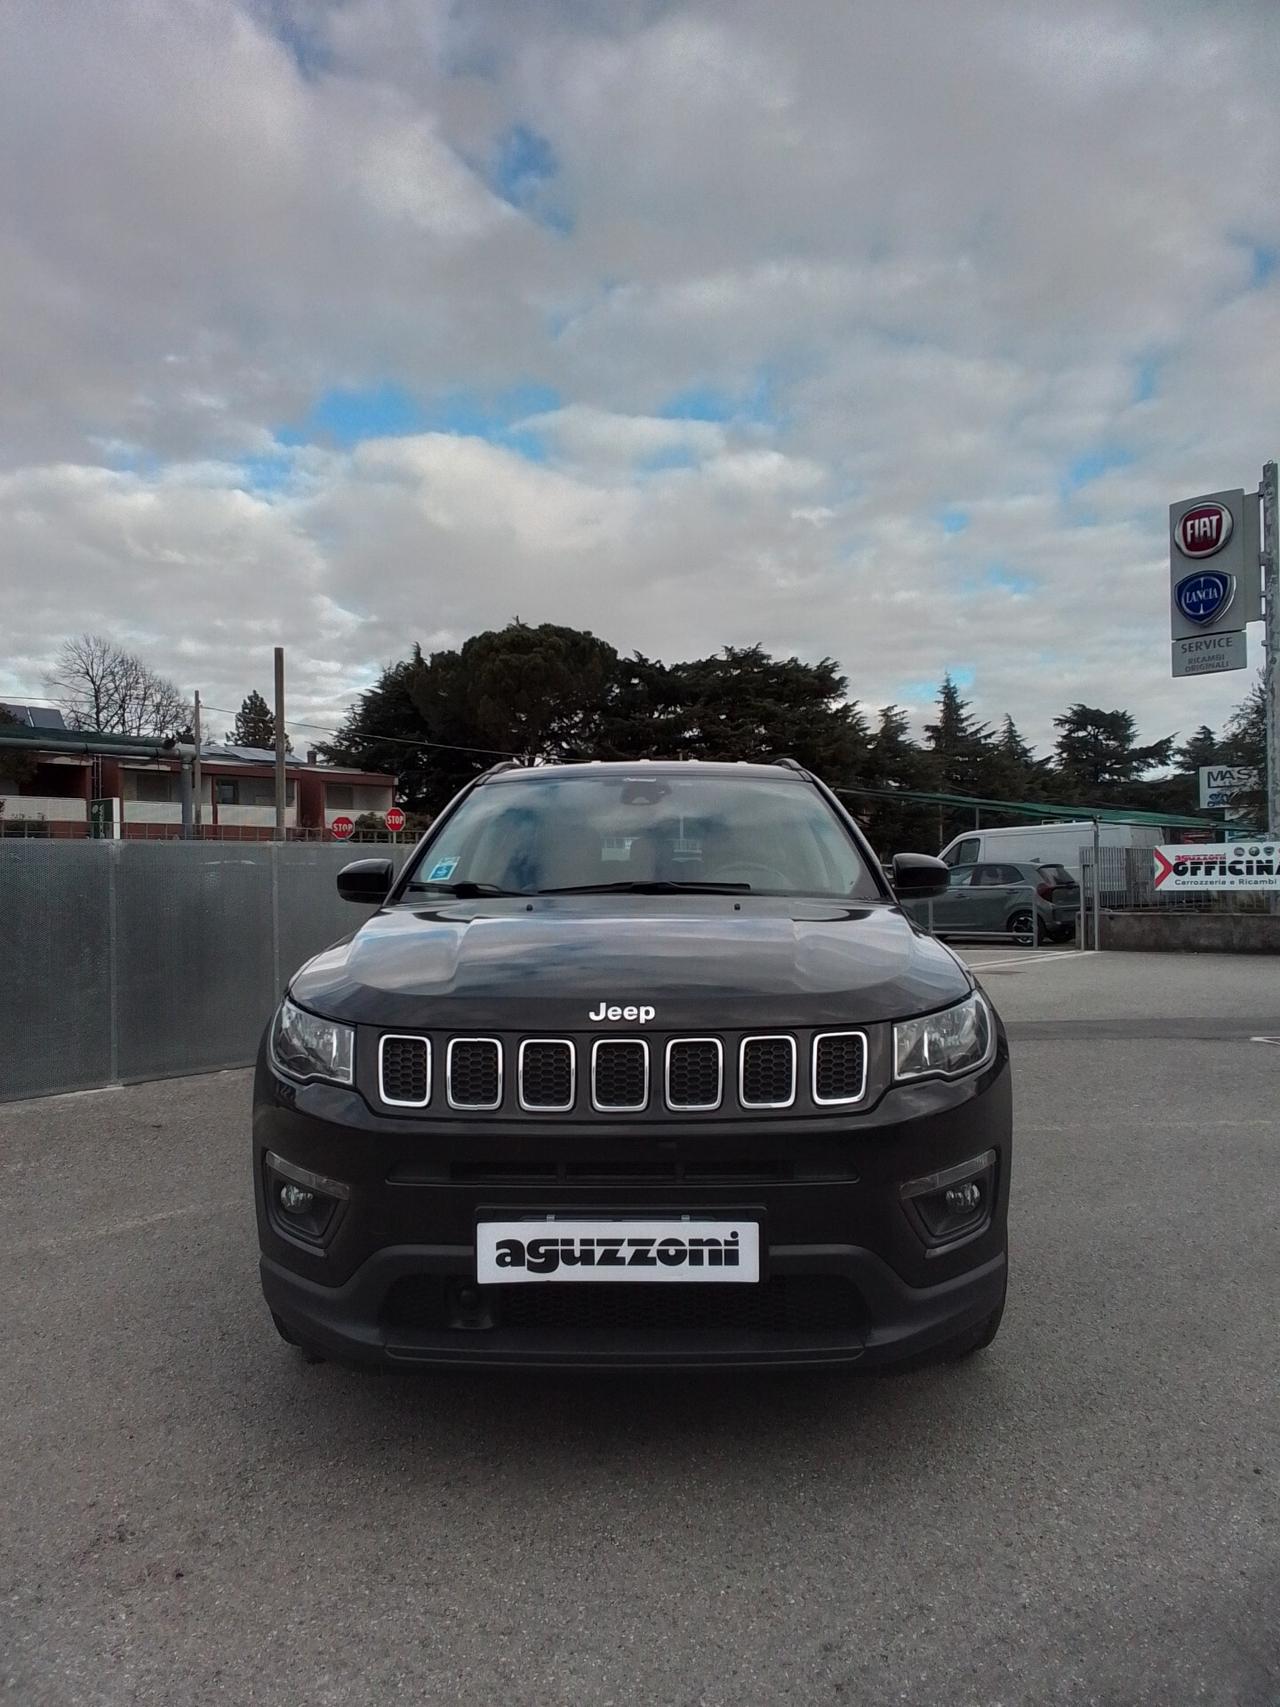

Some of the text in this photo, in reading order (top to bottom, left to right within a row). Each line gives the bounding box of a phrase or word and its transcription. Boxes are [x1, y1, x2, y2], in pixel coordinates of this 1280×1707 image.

[1186, 514, 1220, 543] FIAT
[1185, 588, 1218, 604] LANCIA
[1181, 637, 1233, 653] SERVICE
[1187, 654, 1225, 665] RICAMBI
[1184, 662, 1229, 673] ORIGINALI
[387, 815, 403, 824] STOP
[333, 823, 353, 832] STOP
[1238, 878, 1277, 886] Ricambi
[589, 1002, 655, 1023] Jeep
[495, 1230, 740, 1273] aguzzoni
